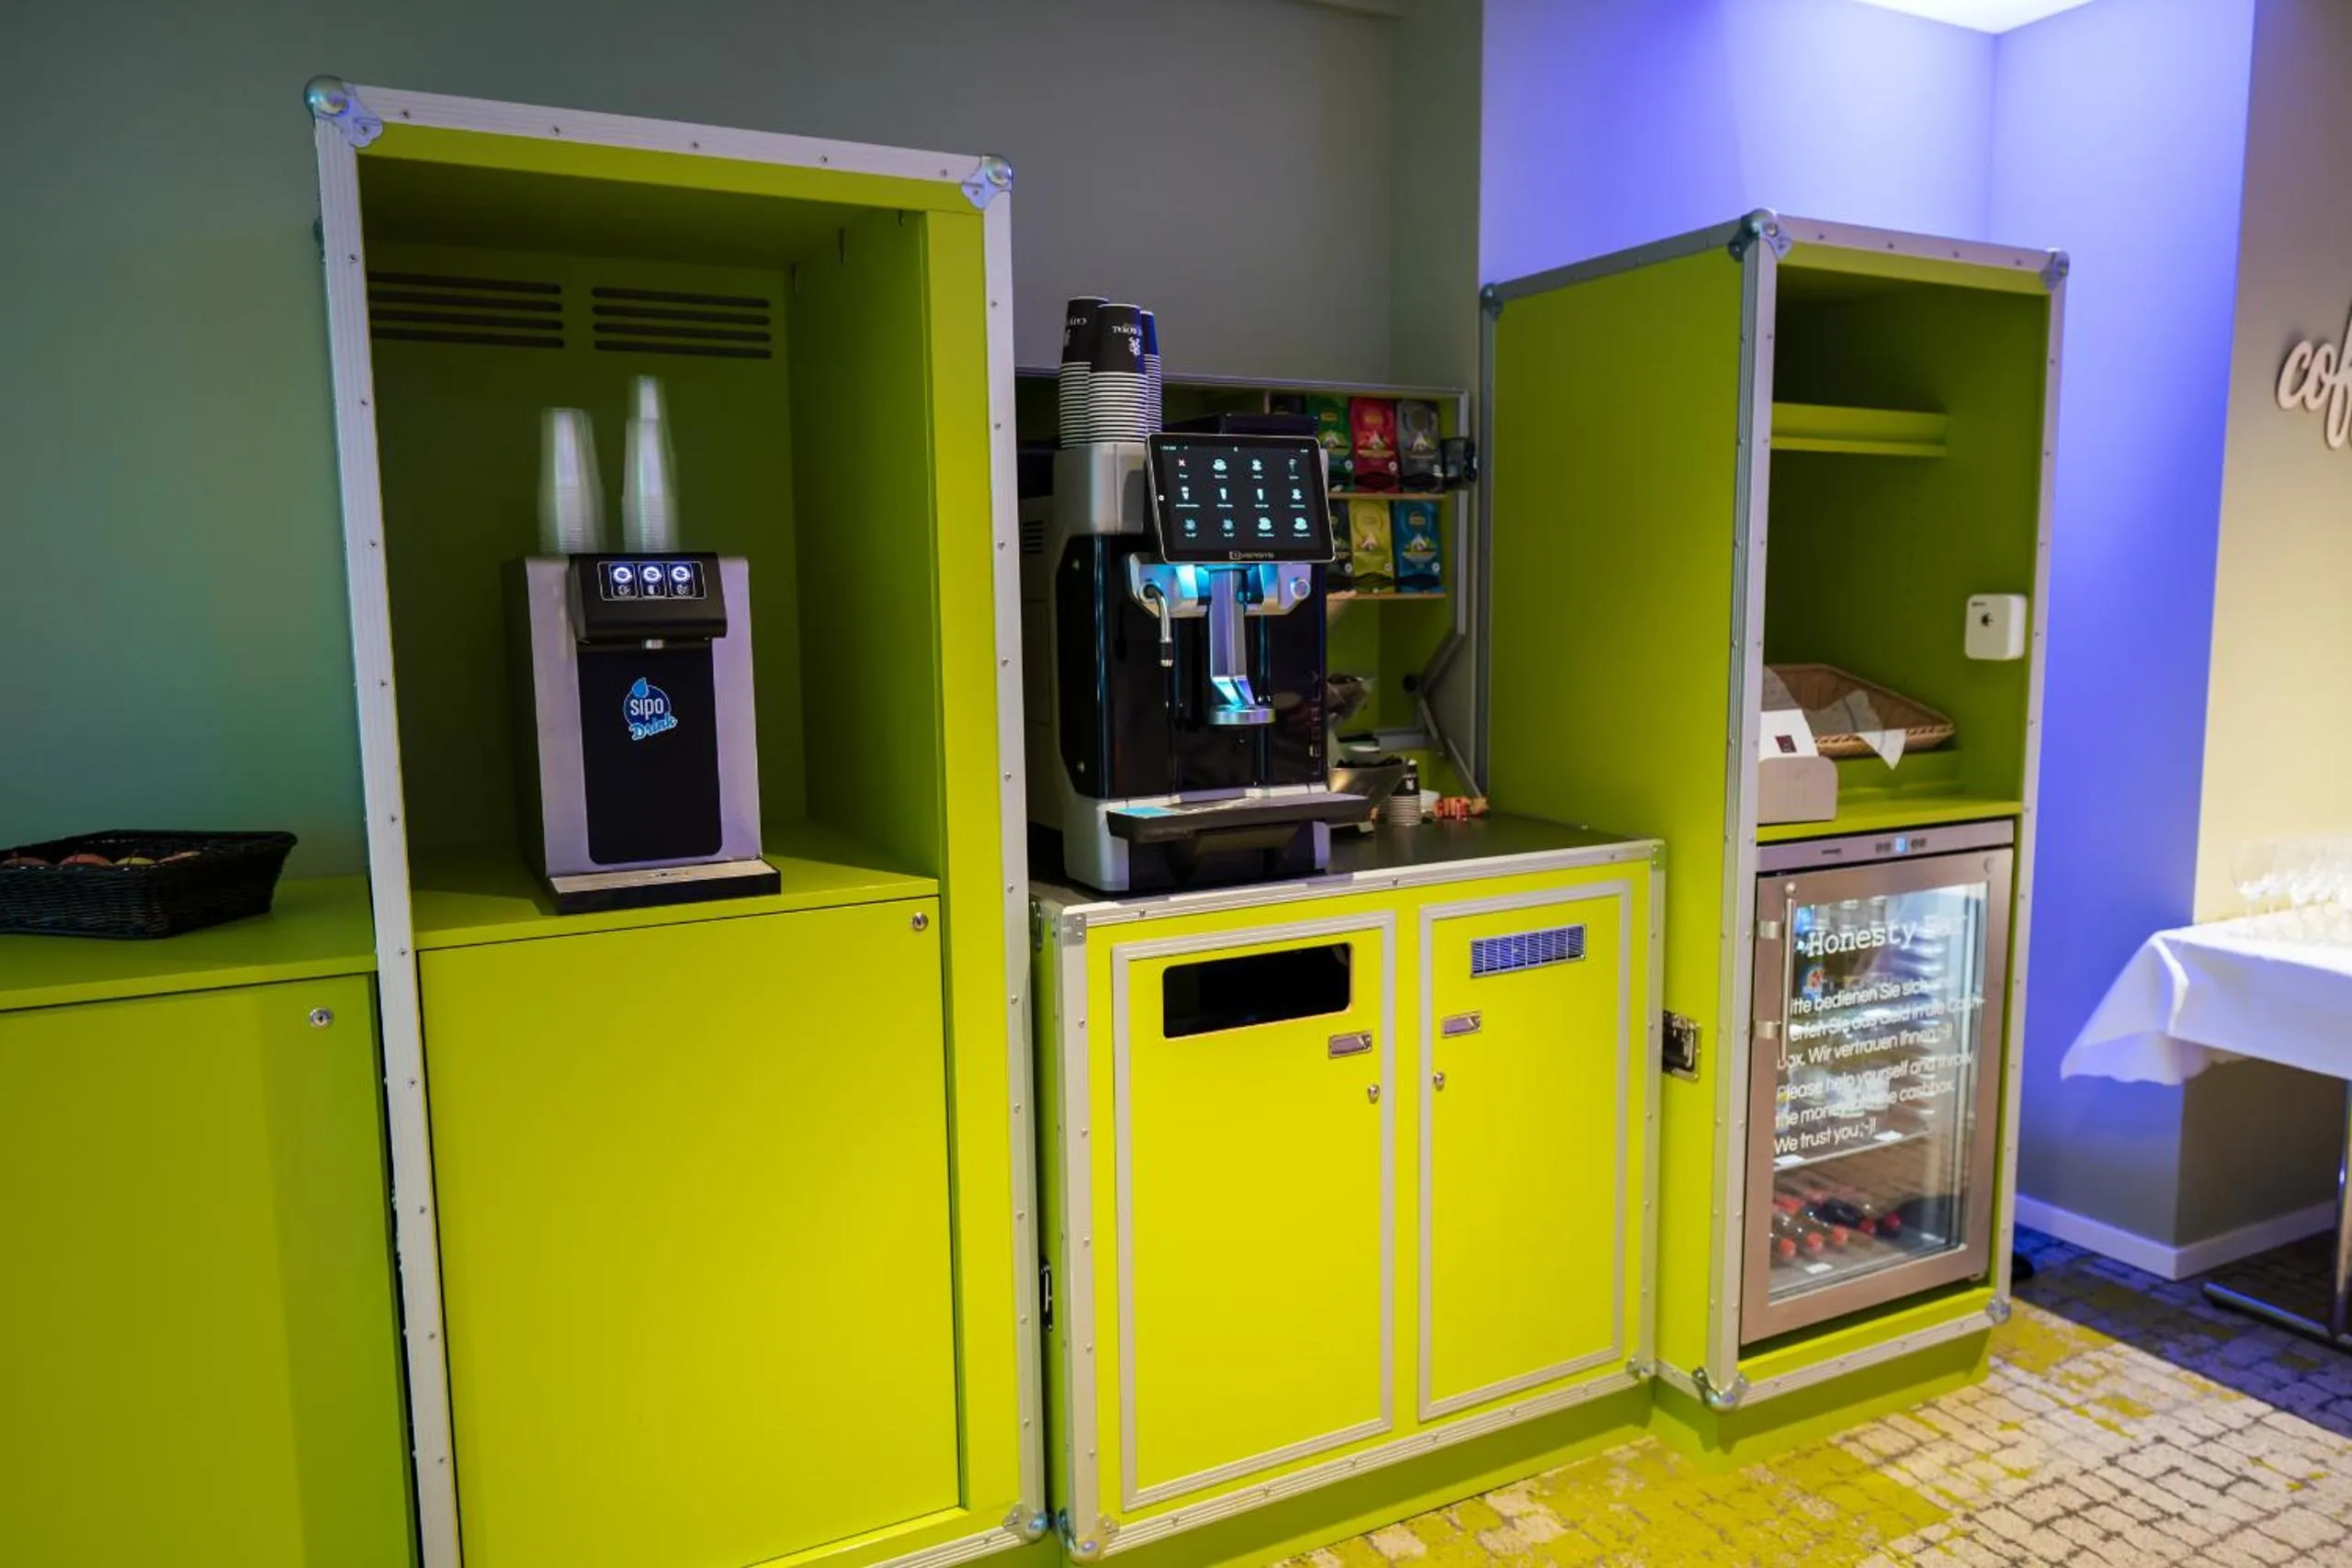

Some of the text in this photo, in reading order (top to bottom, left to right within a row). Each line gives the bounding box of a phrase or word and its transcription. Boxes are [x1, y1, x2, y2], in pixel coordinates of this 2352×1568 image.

[2277, 317, 2352, 449] cof
[630, 698, 664, 720] sipo
[1807, 920, 1917, 957] Honesty
[1815, 988, 1878, 1011] bedienen
[1880, 982, 1901, 999] Sie
[1790, 1020, 1826, 1042] erfen
[1808, 1047, 1831, 1066] Wir
[1834, 1034, 1898, 1060] vertrauen
[1856, 1060, 1909, 1089] yourself
[1774, 1135, 1798, 1155] We
[1800, 1126, 1832, 1148] trust
[1834, 1125, 1859, 1145] you
